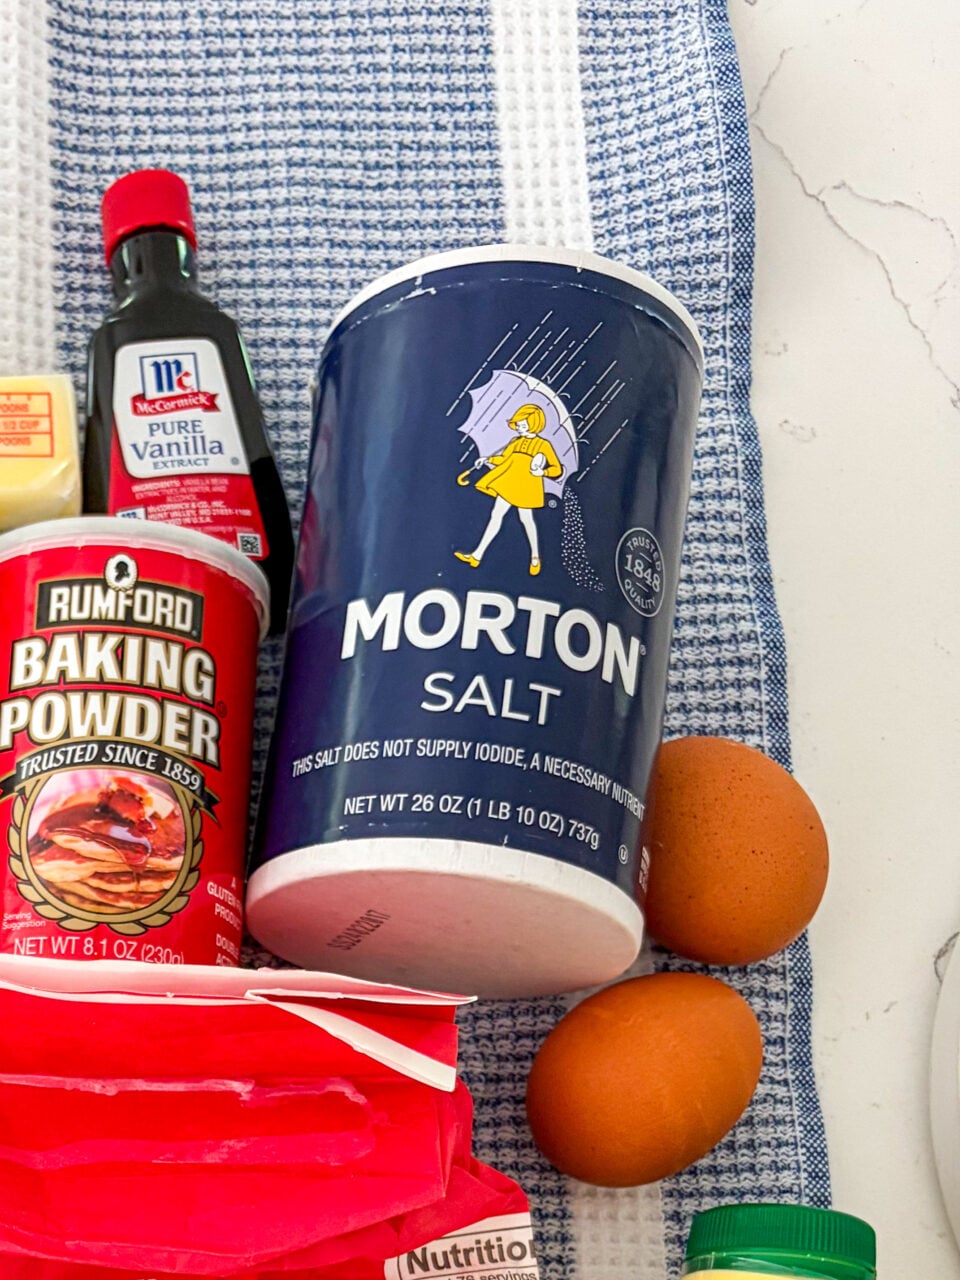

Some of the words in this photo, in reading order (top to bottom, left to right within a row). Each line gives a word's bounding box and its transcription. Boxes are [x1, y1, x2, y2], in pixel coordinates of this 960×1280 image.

[136, 394, 210, 414] McCormick
[148, 420, 204, 437] PURE
[131, 436, 224, 461] Vanilla
[152, 458, 209, 470] EXTRACT
[624, 553, 661, 592] 1848
[49, 585, 193, 633] RUMFORD
[341, 589, 640, 696] MORTON
[10, 632, 215, 705] BAKING
[421, 672, 561, 725] SALT
[20, 744, 96, 780] TRUSTED
[102, 744, 157, 771] SINCE
[161, 757, 201, 791] 1859
[292, 755, 313, 778] THIS
[314, 747, 342, 769] SALT
[344, 741, 380, 762] DOES
[383, 739, 413, 757] NOT
[416, 739, 471, 759] SUPPLY
[475, 743, 527, 771] IODIDE,
[530, 753, 540, 771] A
[544, 756, 612, 795] NECESSARY
[612, 782, 645, 821] NUTRIENT
[344, 795, 377, 815] NET
[380, 794, 408, 811] WT
[411, 794, 434, 812] 26
[439, 795, 464, 814] OZ
[467, 798, 481, 819] (1
[488, 800, 511, 820] LB
[516, 806, 535, 826] 10
[539, 811, 564, 837] OZ)
[568, 819, 599, 850] 737g
[2, 920, 46, 931] Suggestion
[3, 912, 31, 921] Serving
[14, 937, 47, 955] NET
[48, 936, 80, 954] WT
[83, 937, 107, 956] 8.1
[113, 940, 137, 960] OZ
